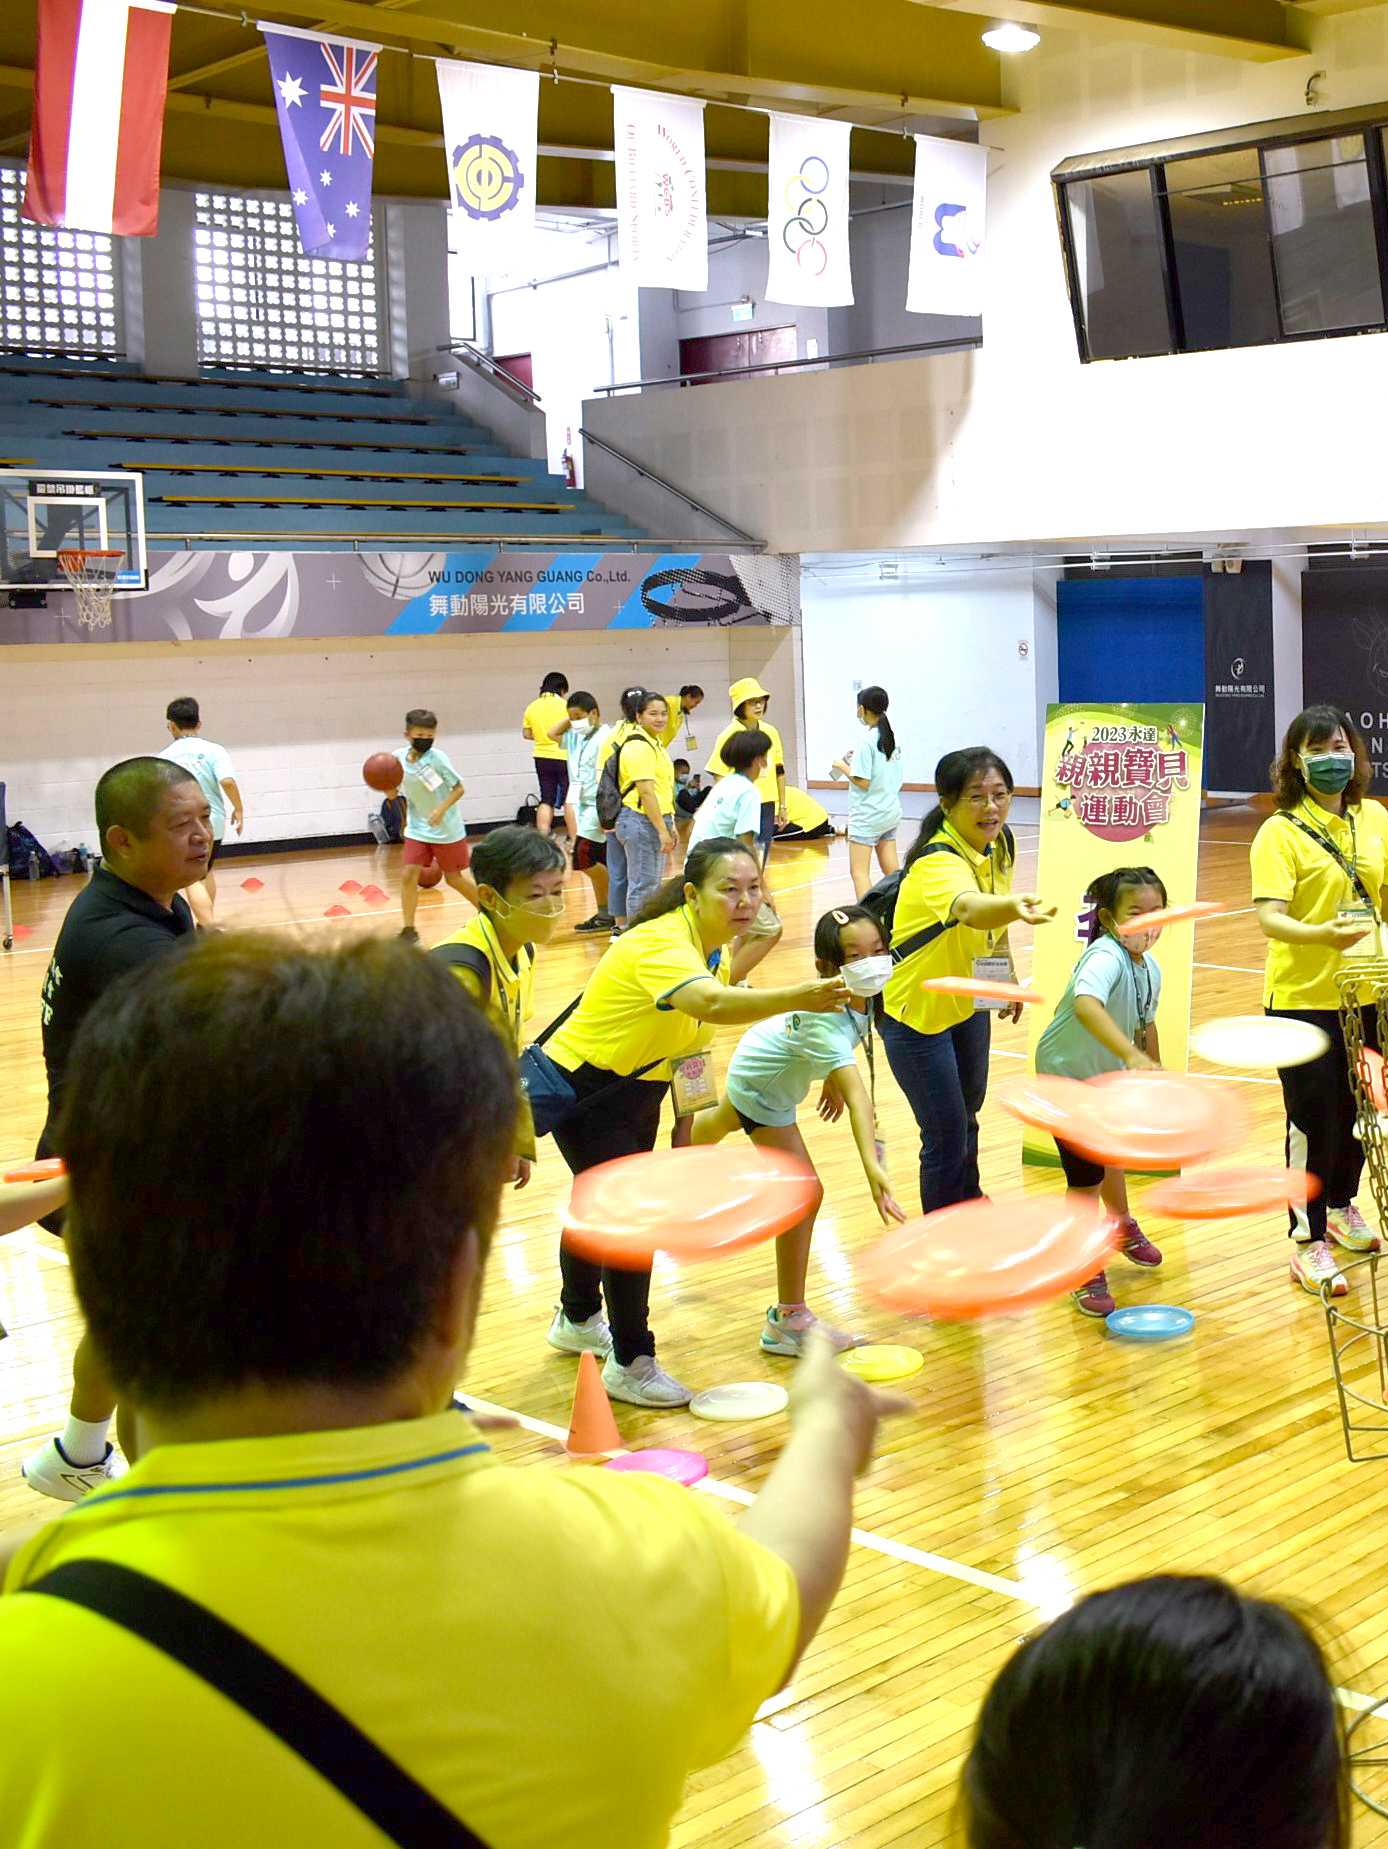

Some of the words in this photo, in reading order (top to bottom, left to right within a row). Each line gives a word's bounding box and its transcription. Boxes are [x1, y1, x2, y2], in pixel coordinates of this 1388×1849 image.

[428, 571, 451, 583] WU
[456, 571, 494, 583] DONG
[499, 571, 533, 583] YANG
[537, 570, 583, 583] GUANG
[587, 570, 631, 583] Co.,Ltd.
[429, 592, 585, 617] 舞動陽光有限公司
[1091, 726, 1157, 742] 2023永達
[1055, 748, 1190, 790] 親親寶貝
[1081, 792, 1169, 826] 運動會
